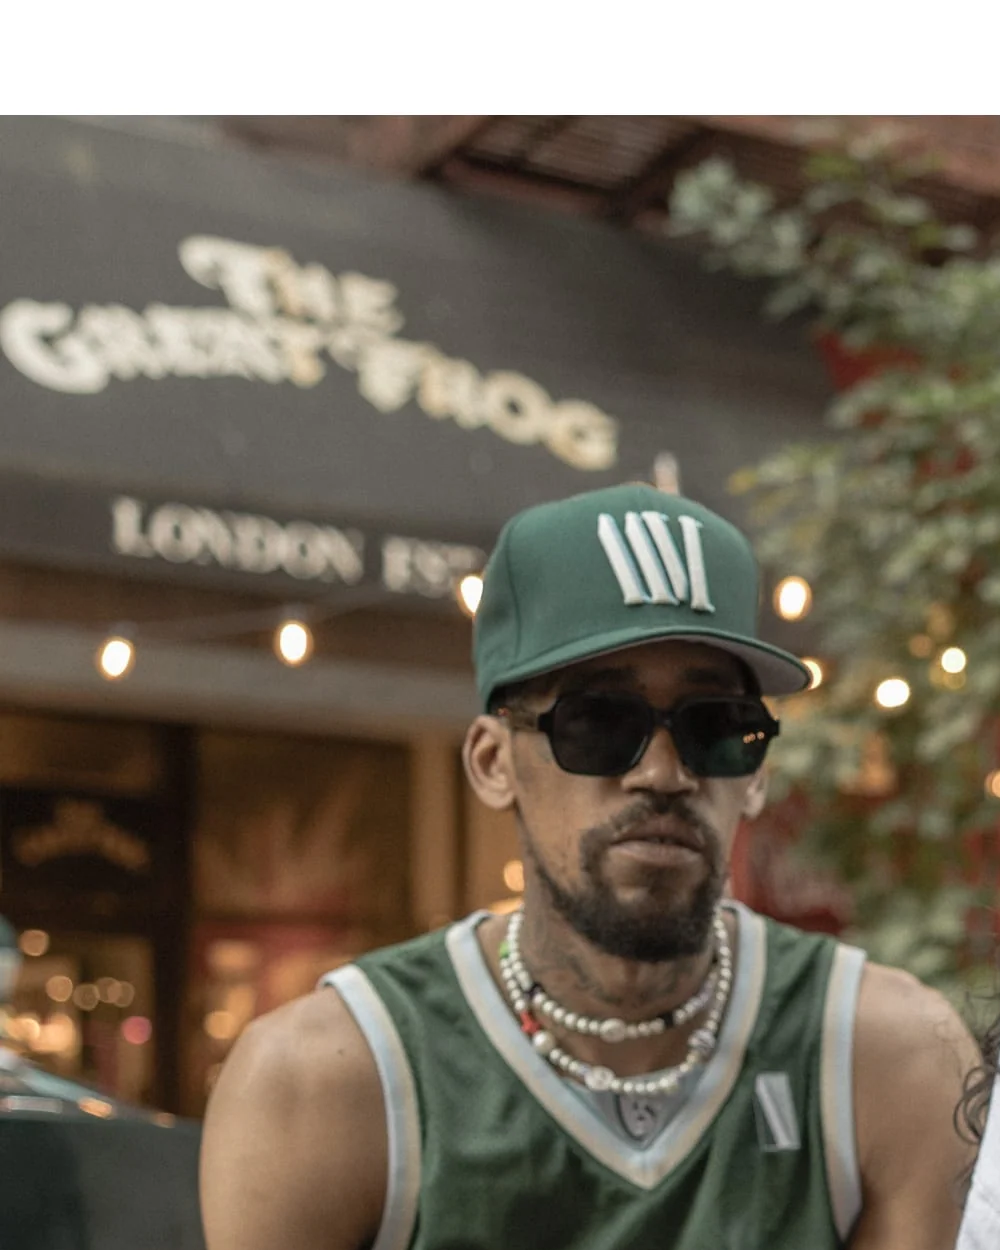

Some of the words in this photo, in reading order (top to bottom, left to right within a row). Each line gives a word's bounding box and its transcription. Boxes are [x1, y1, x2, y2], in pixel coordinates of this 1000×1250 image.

[179, 235, 403, 334] THE
[0, 299, 325, 394] GREAT
[330, 328, 620, 471] FROG
[112, 496, 364, 585] LONDON
